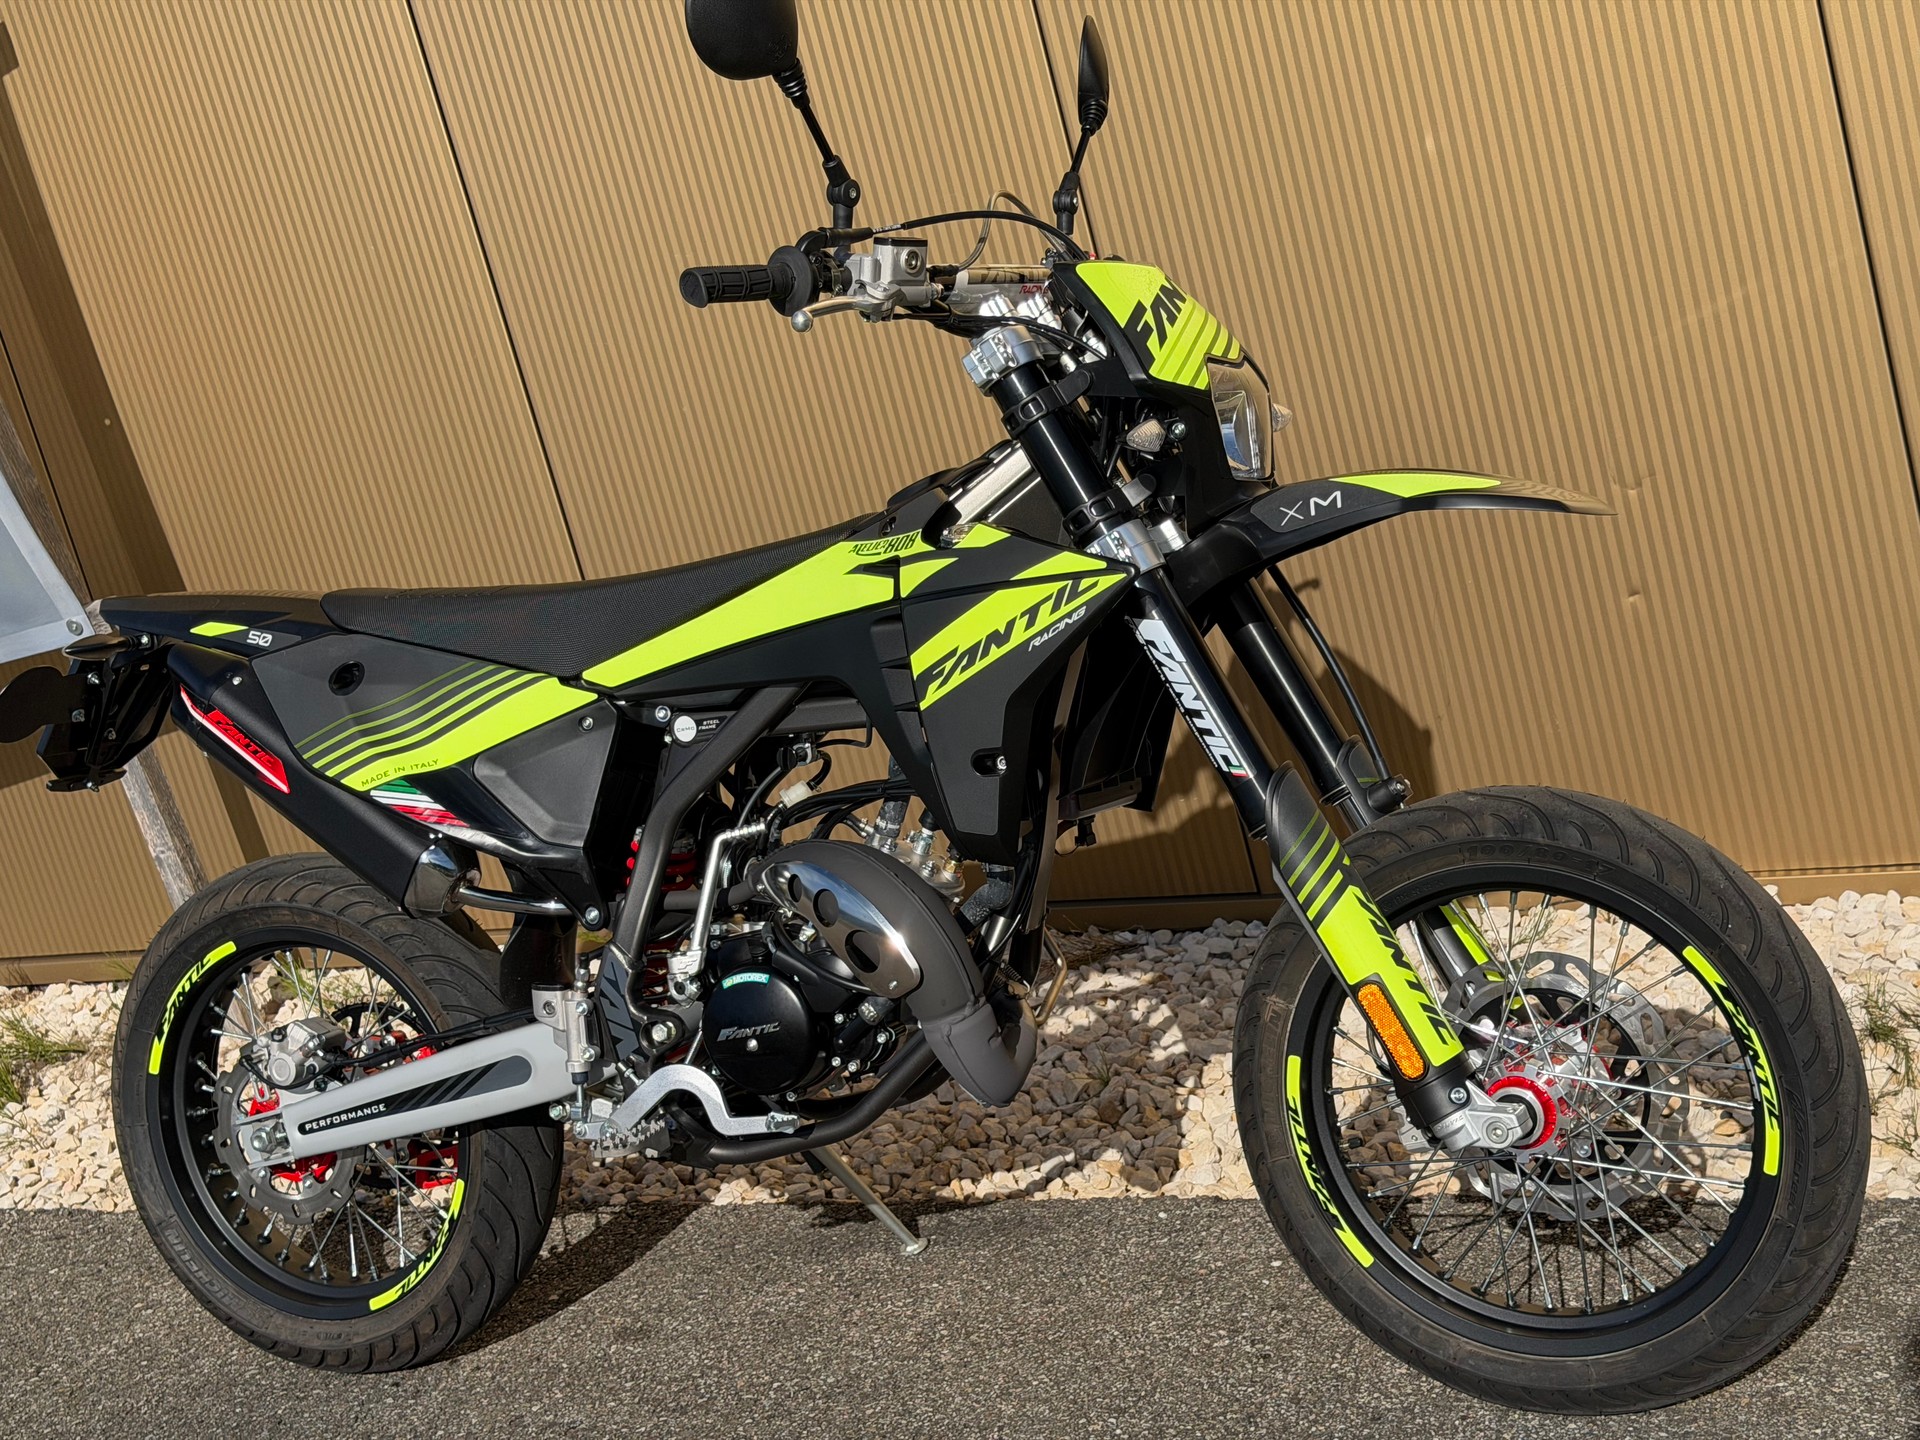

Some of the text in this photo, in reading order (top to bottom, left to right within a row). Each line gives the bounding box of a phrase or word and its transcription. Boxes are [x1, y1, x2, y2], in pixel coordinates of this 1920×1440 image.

[1280, 490, 1341, 526] XM
[246, 630, 273, 647] 50
[915, 578, 1101, 700] FANTIC
[1028, 606, 1086, 651] RACING
[1138, 619, 1241, 772] FANTIC
[207, 709, 275, 768] FANTIC
[361, 759, 439, 787] MADE IN ITALY
[733, 972, 769, 984] MOTOREX
[717, 1021, 780, 1041] FANTIC
[305, 1103, 387, 1131] PERFORMANCE
